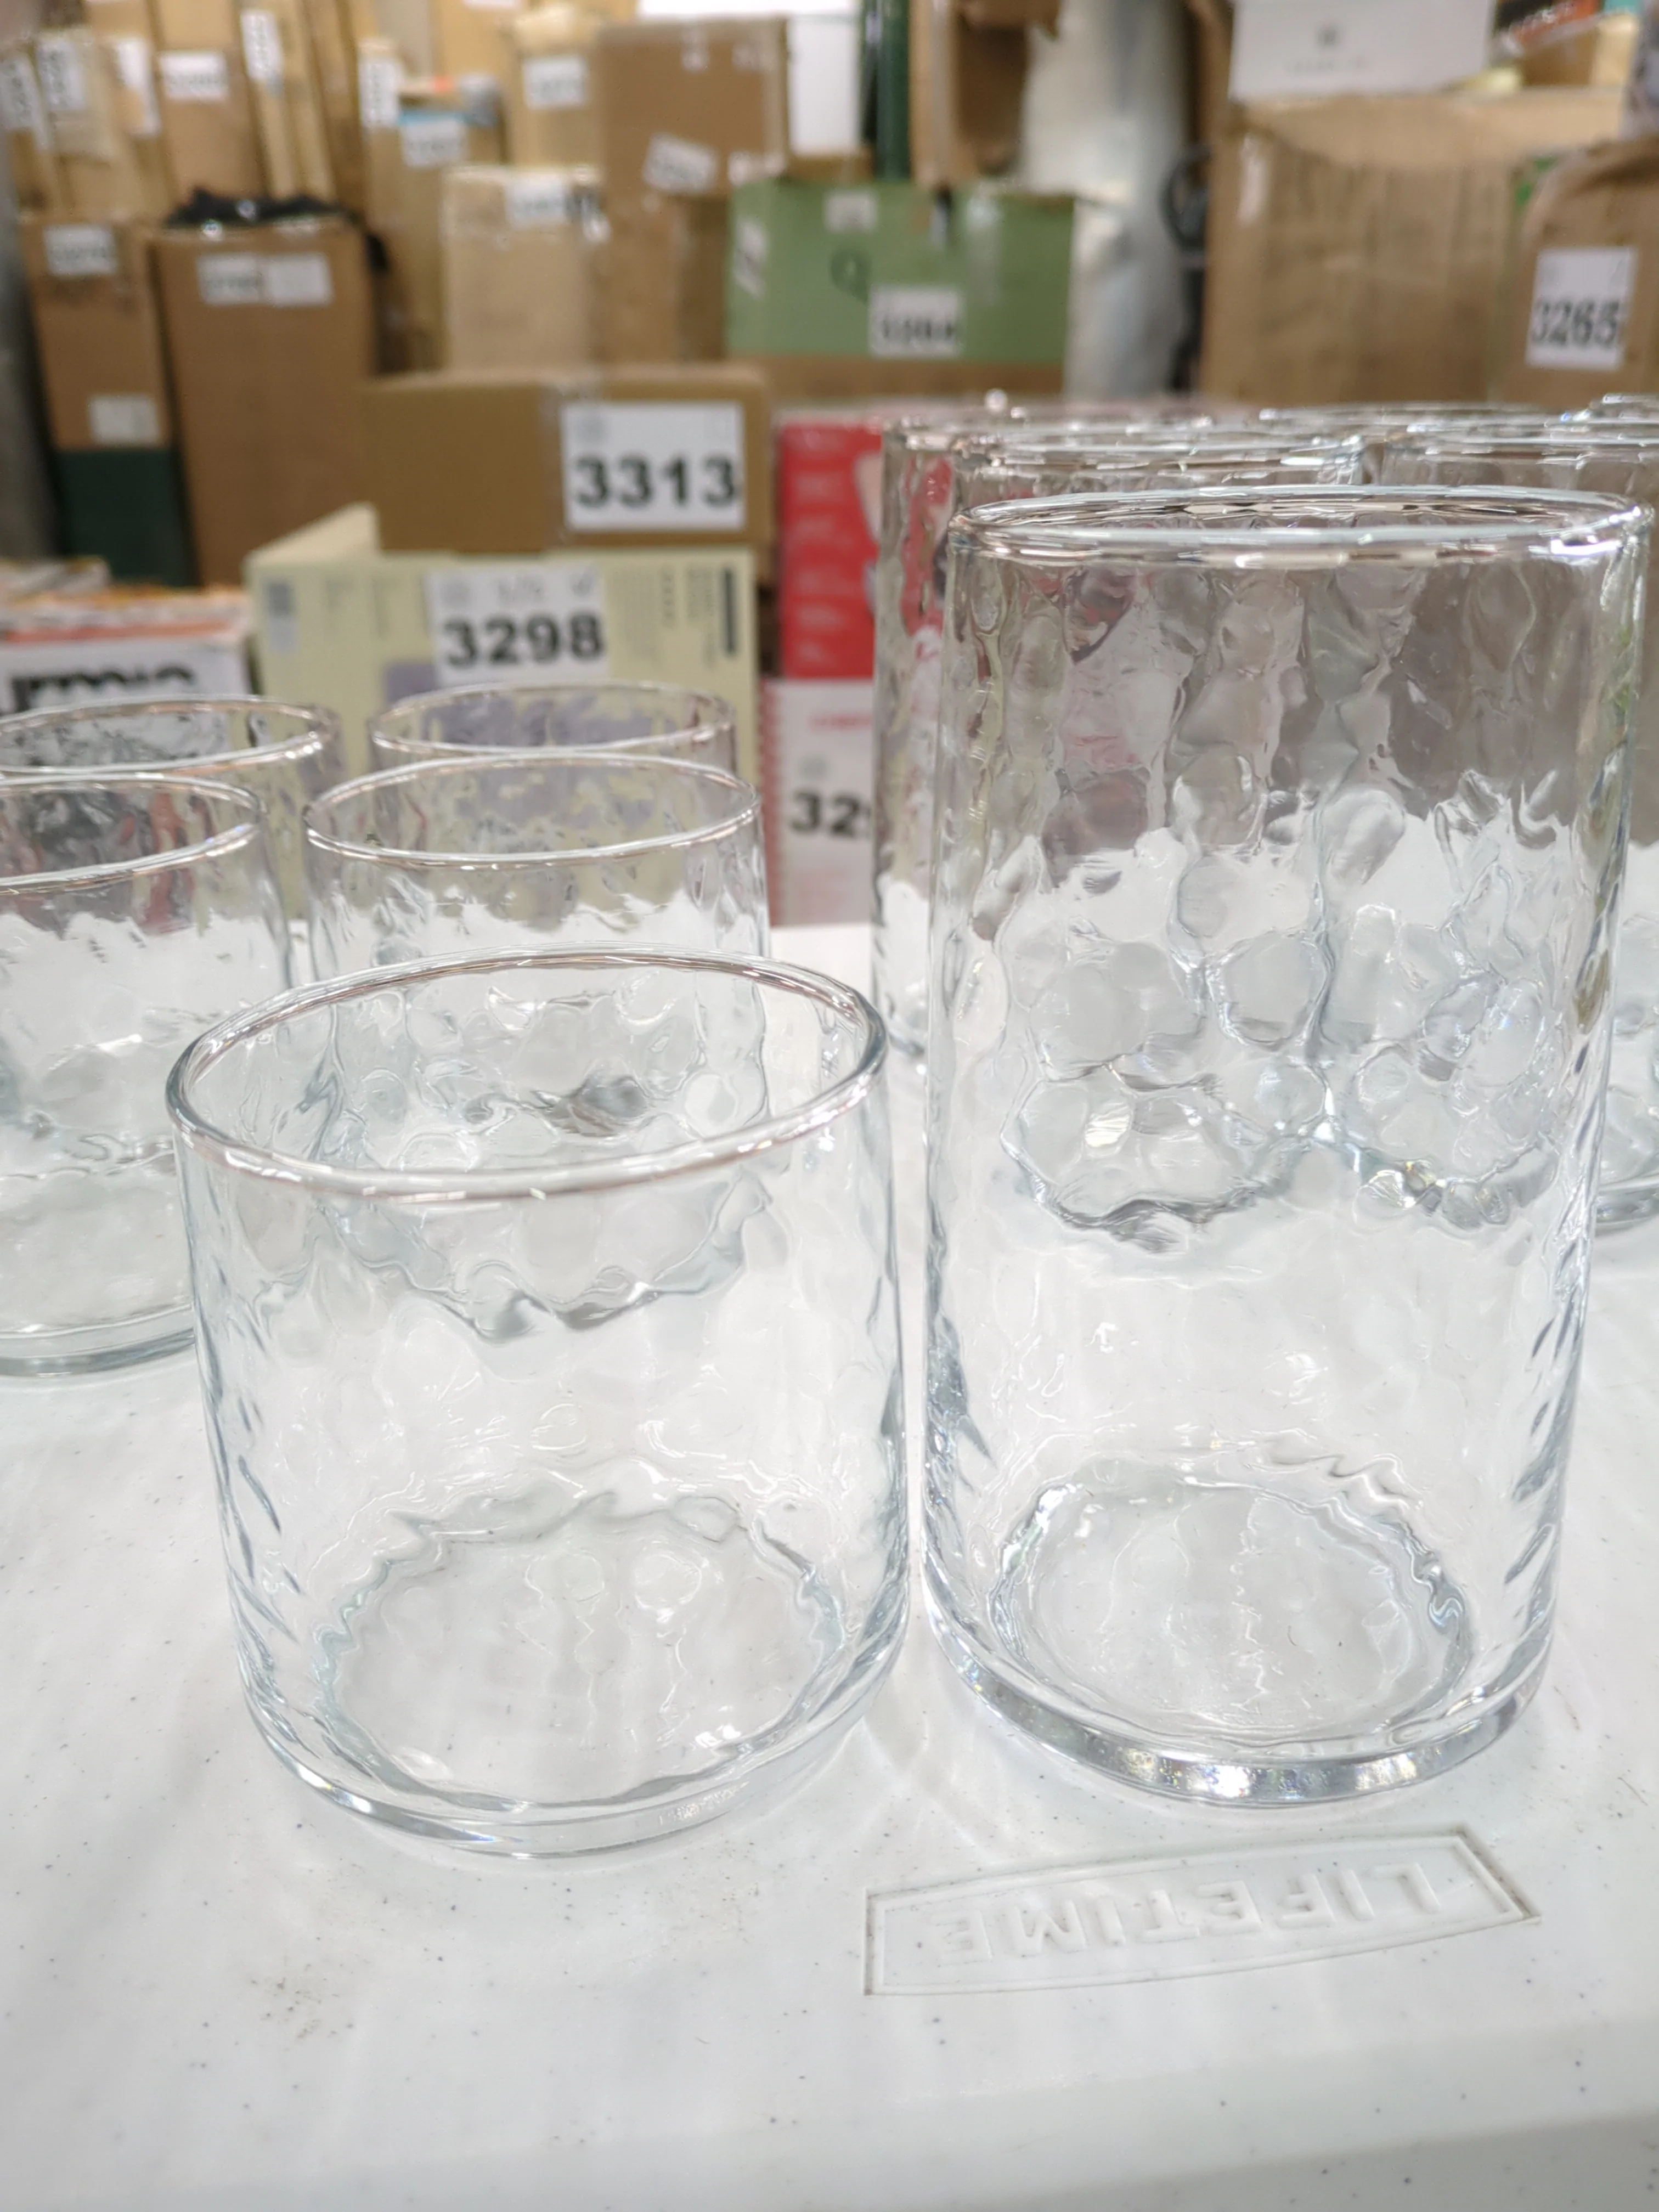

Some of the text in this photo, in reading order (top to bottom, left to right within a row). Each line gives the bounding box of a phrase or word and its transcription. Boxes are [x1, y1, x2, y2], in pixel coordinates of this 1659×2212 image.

[1532, 297, 1621, 349] 3265
[573, 455, 737, 509] 3313
[442, 611, 606, 668] 3298
[790, 789, 871, 840] 32
[933, 1861, 1441, 1965] LIFETIME
